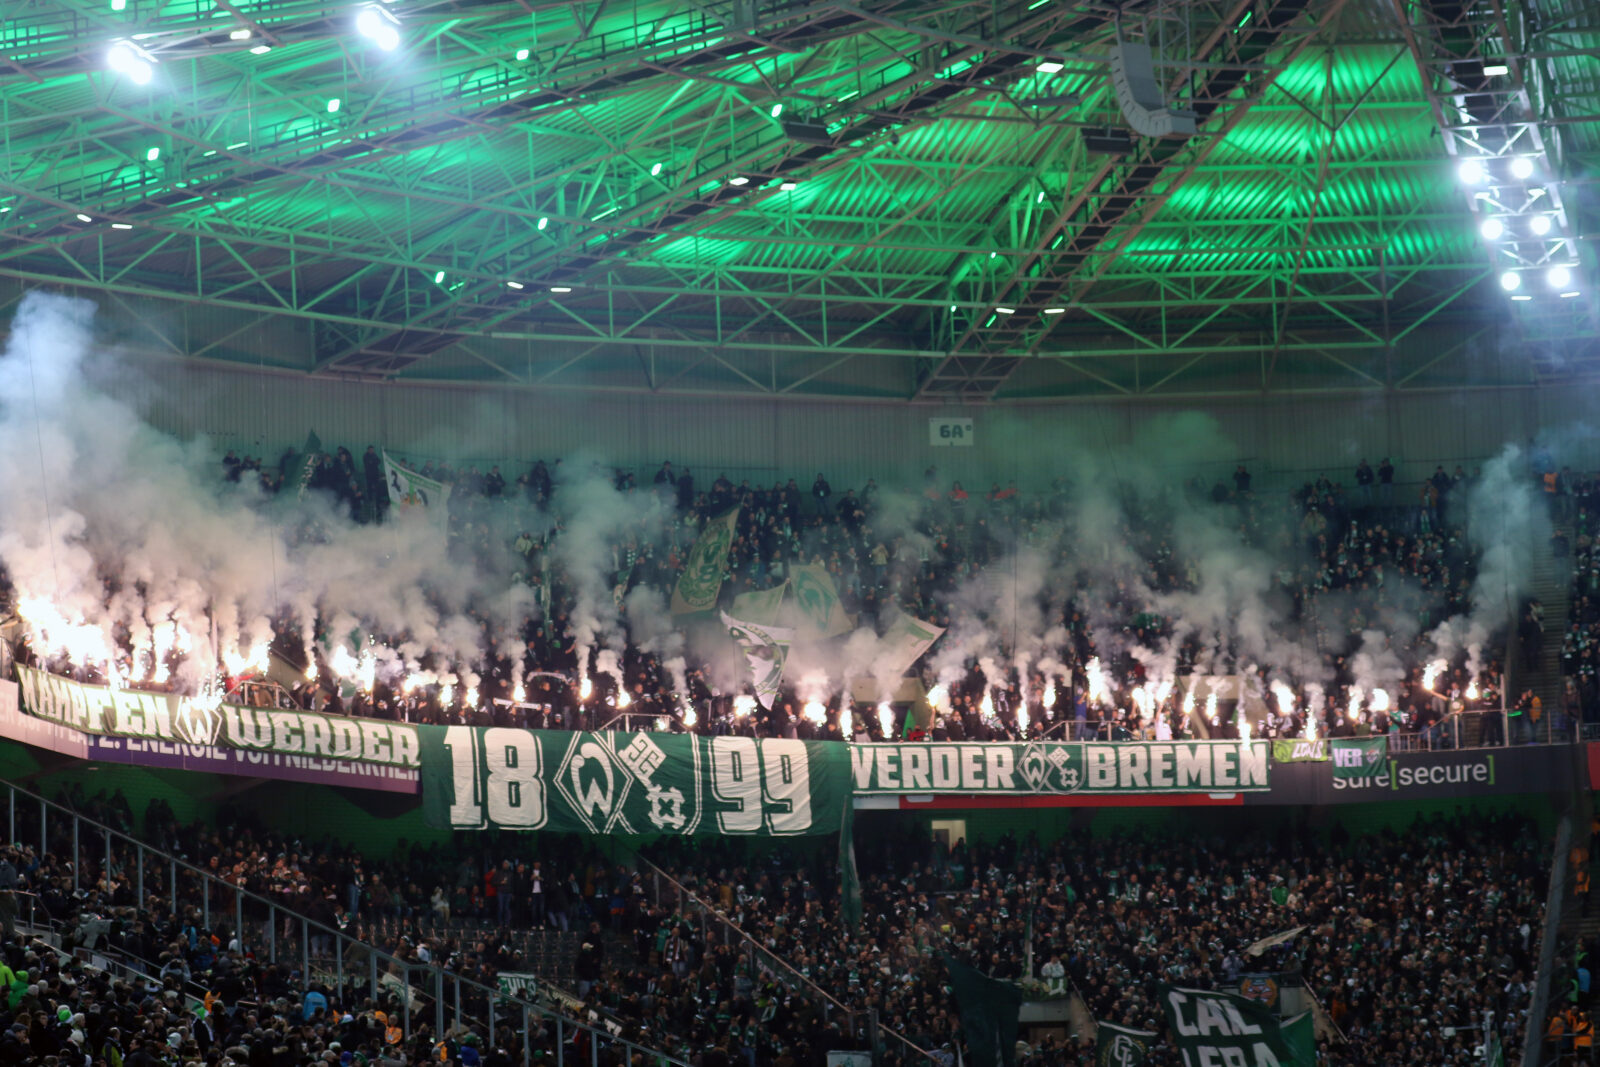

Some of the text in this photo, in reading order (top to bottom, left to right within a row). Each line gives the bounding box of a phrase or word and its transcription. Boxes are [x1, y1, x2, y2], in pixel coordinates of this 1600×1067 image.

[220, 704, 421, 767] WERDER
[1333, 748, 1363, 767] VER
[443, 726, 548, 830] 18
[709, 735, 812, 836] 99
[1088, 743, 1269, 788] BREMEN
